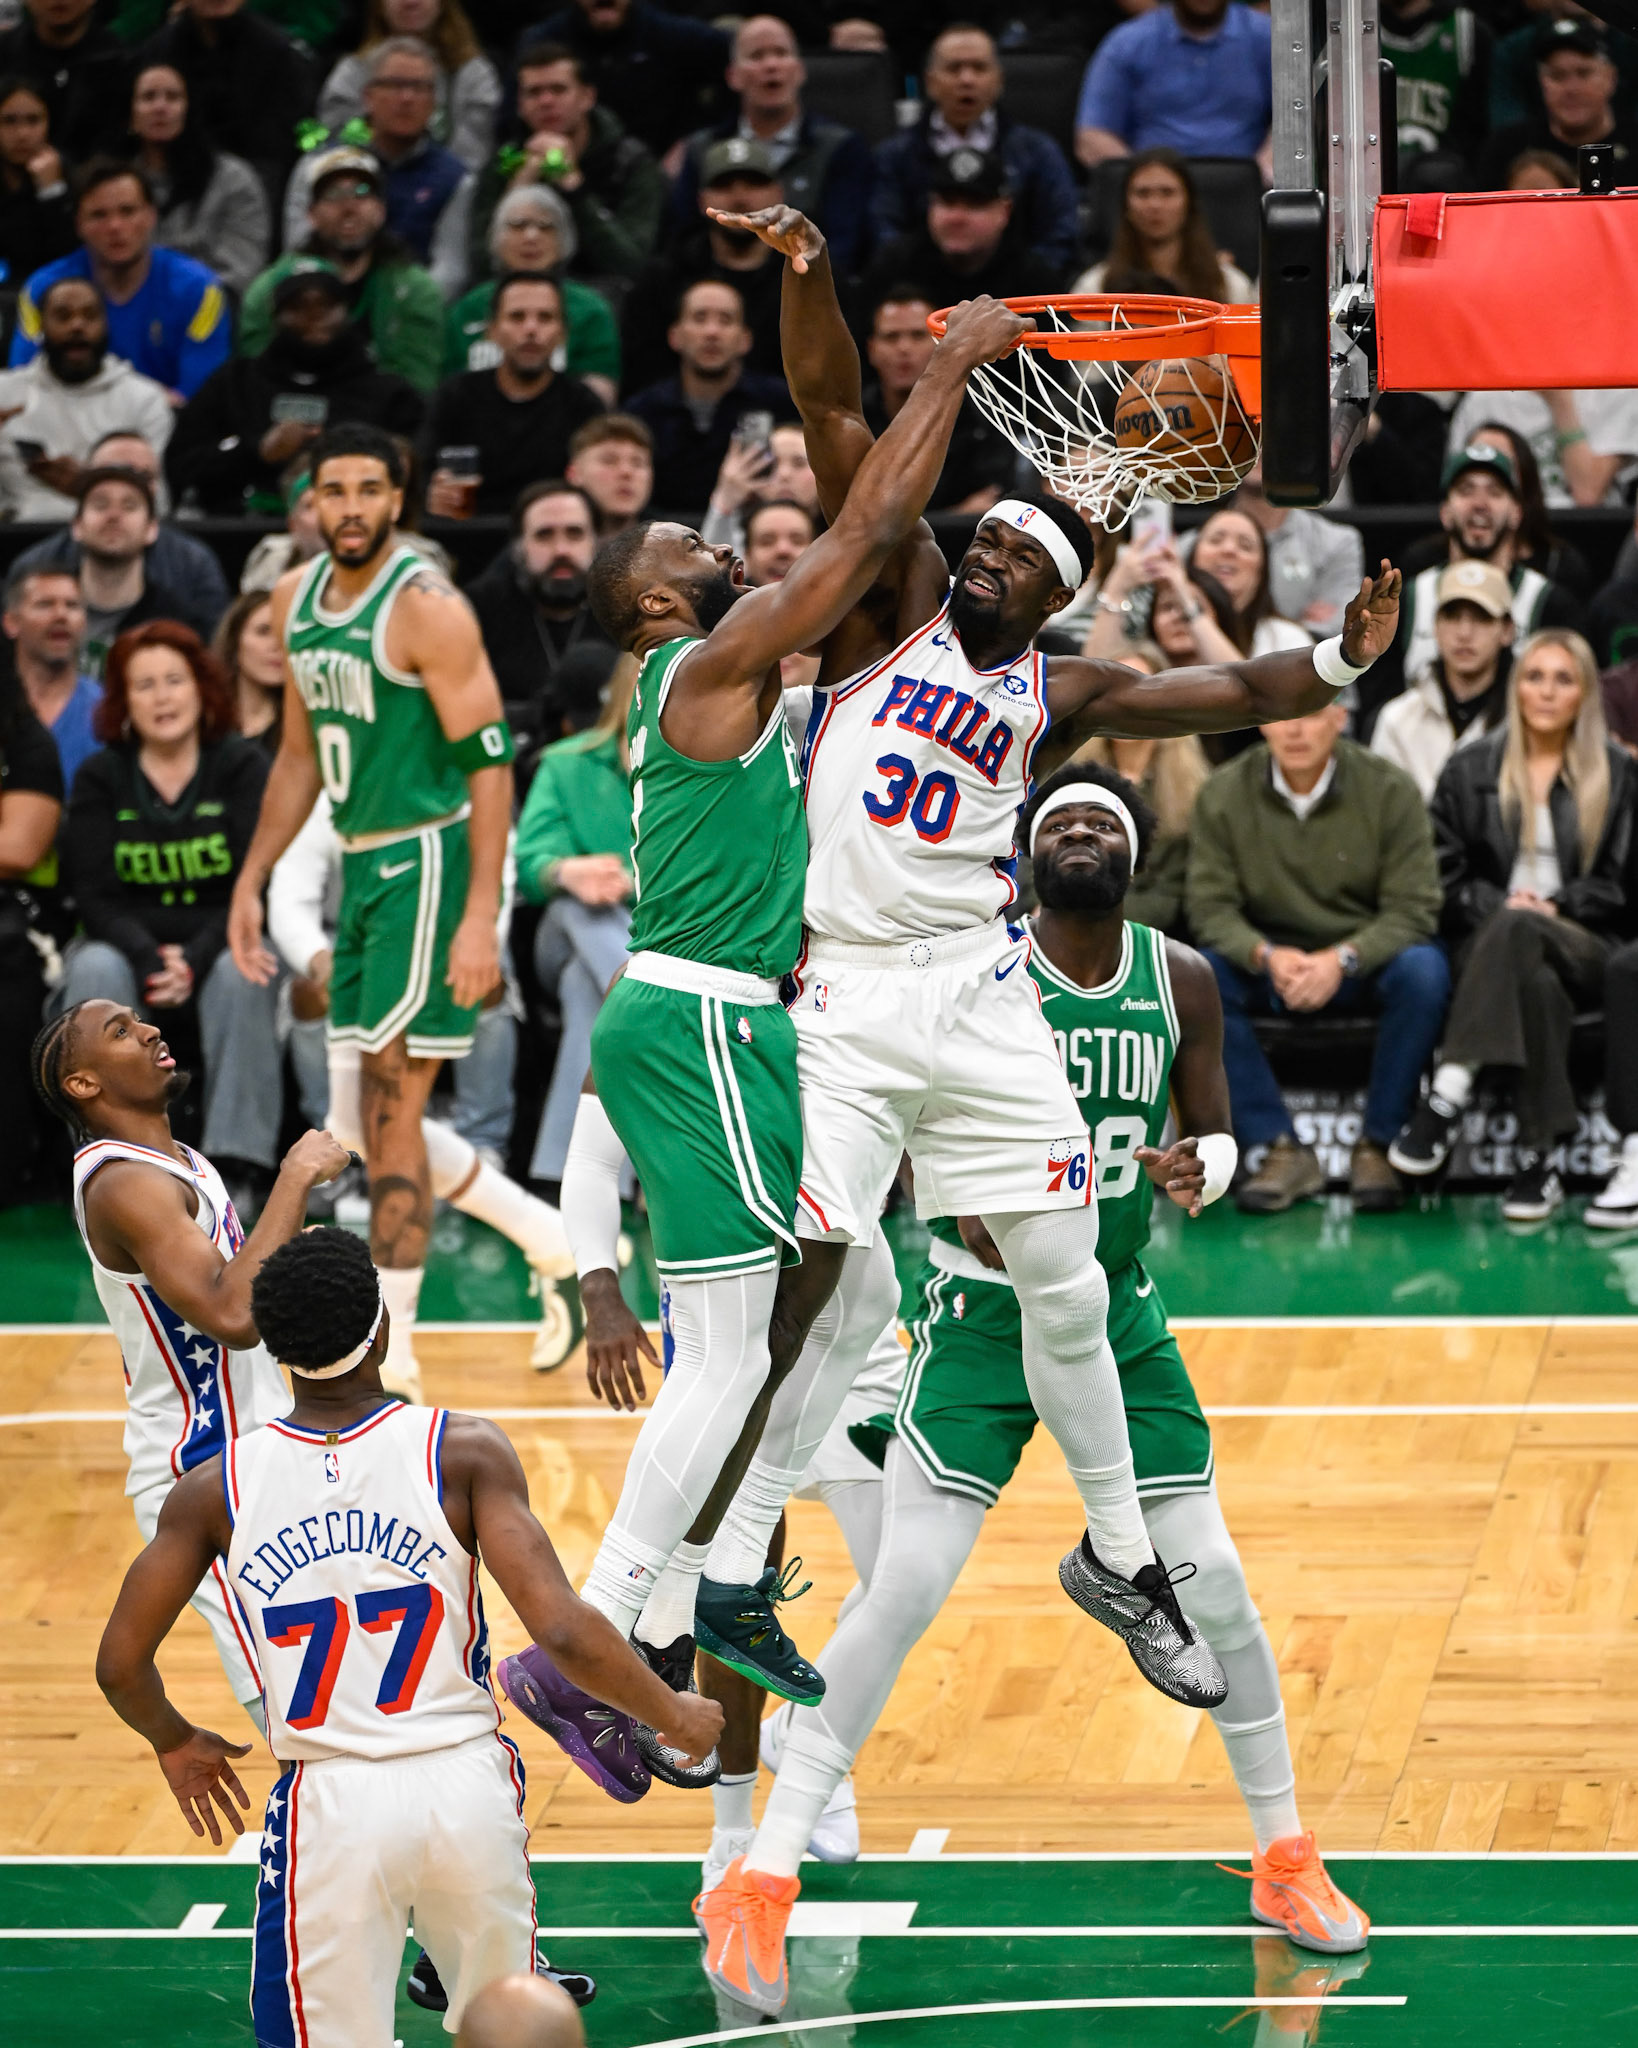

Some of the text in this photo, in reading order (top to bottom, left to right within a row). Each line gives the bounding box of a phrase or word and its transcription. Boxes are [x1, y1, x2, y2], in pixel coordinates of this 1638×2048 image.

[1115, 404, 1196, 438] Wilson
[991, 688, 1036, 709] crypto.com
[480, 726, 505, 757] 0
[871, 674, 1014, 787] PHILA
[317, 722, 351, 804] 0
[862, 753, 961, 845] 30
[114, 832, 232, 885] CELTICS
[1120, 997, 1160, 1011] Amica
[1046, 1152, 1087, 1193] 76
[238, 1509, 447, 1601] EDGECOMBE
[262, 1583, 445, 1731] 77
